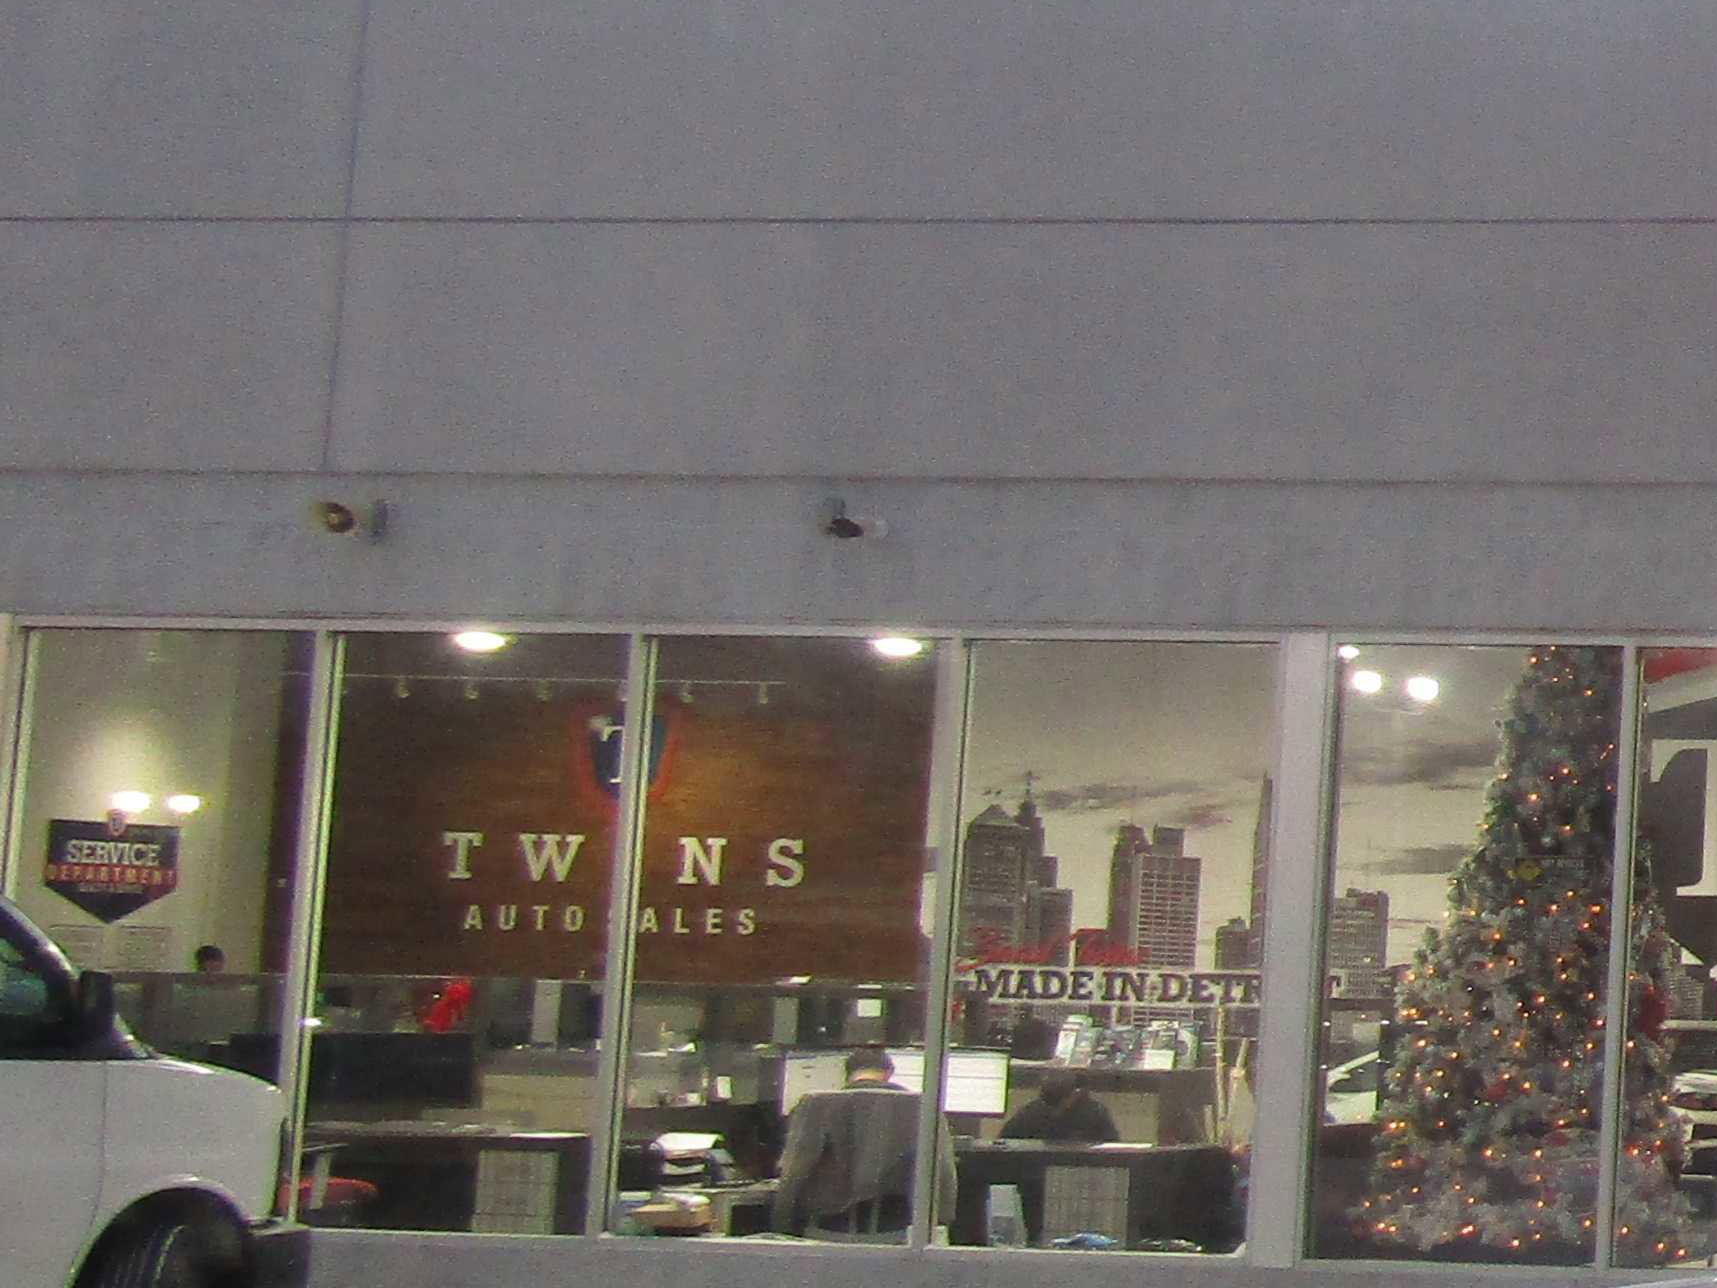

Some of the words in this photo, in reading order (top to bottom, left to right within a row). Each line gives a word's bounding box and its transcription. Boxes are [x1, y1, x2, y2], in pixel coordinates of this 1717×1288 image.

[65, 839, 162, 866] SERVICE
[442, 830, 805, 887] TWNS
[46, 864, 175, 885] DEPARTMENT
[463, 904, 585, 932] AUTO
[637, 907, 756, 936] ALES
[974, 969, 1094, 1000] MADE
[1101, 970, 1150, 1002] IN
